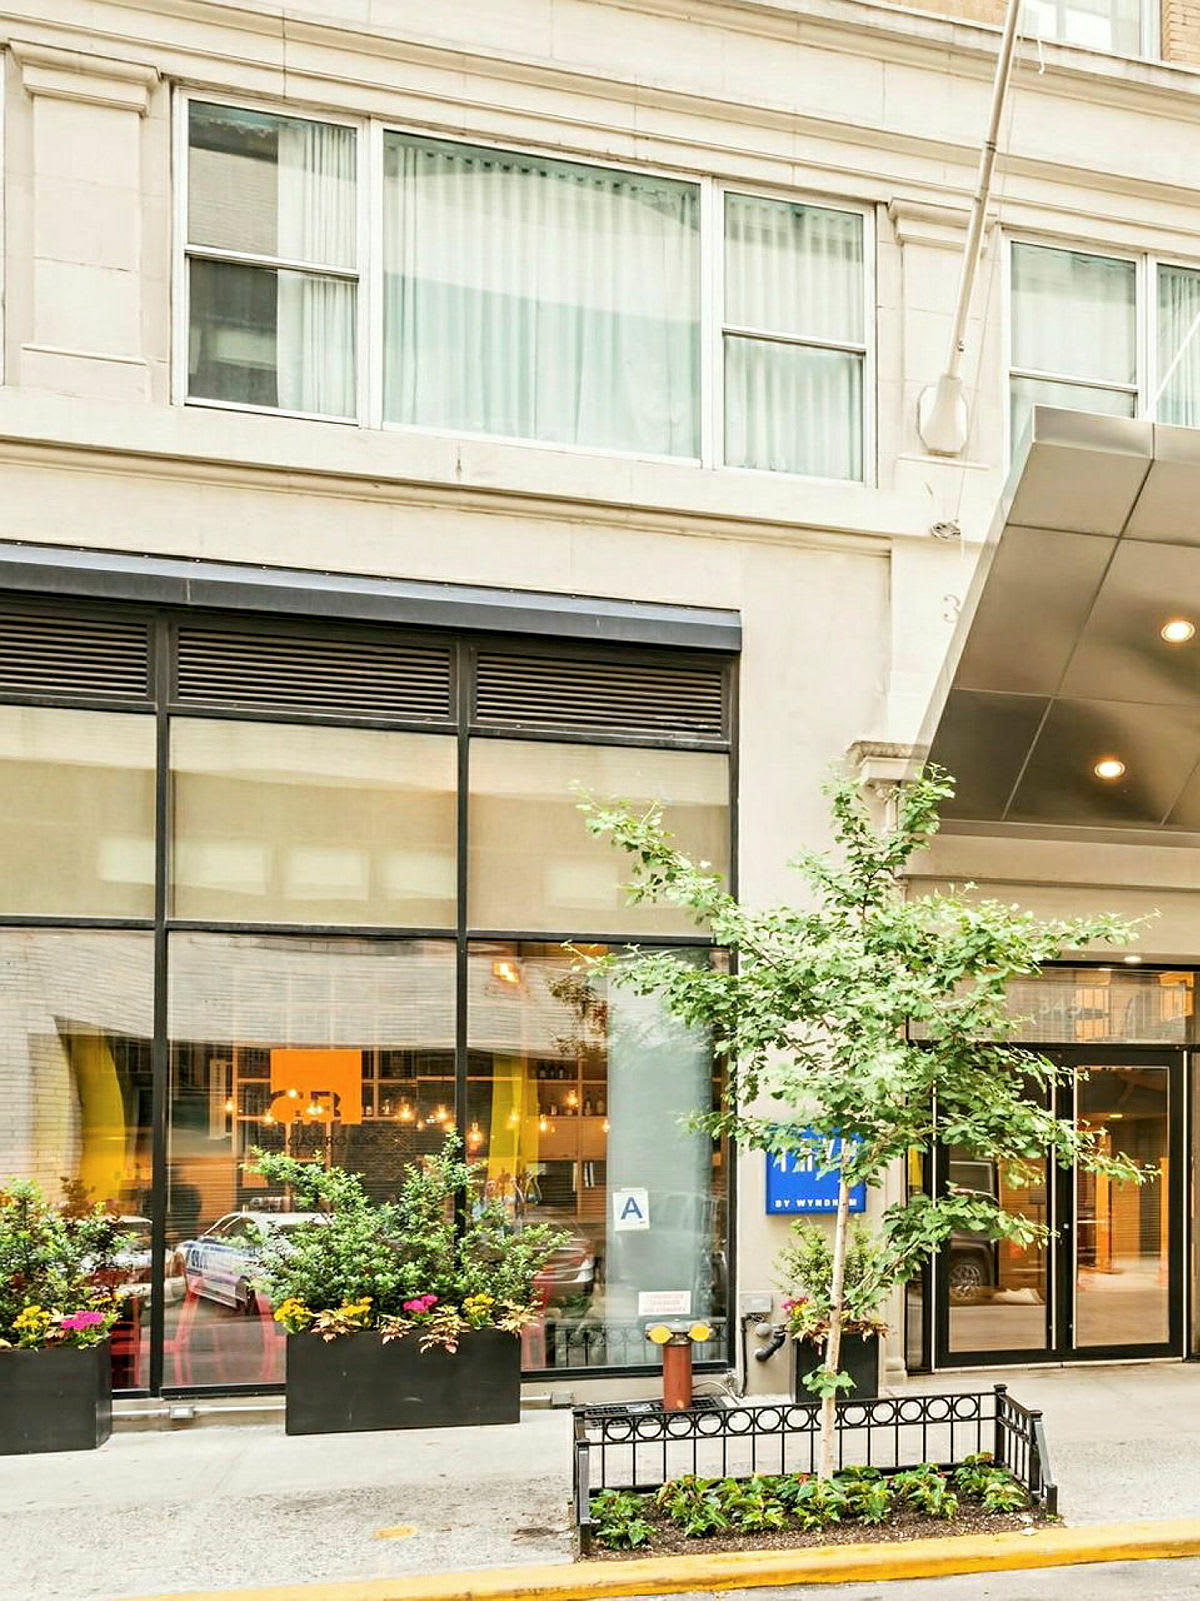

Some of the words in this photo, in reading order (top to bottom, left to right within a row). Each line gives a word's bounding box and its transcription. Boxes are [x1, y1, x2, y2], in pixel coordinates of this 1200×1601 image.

[620, 1196, 643, 1220] A
[775, 1199, 790, 1208] BY
[797, 1199, 857, 1208] WYNDHM
